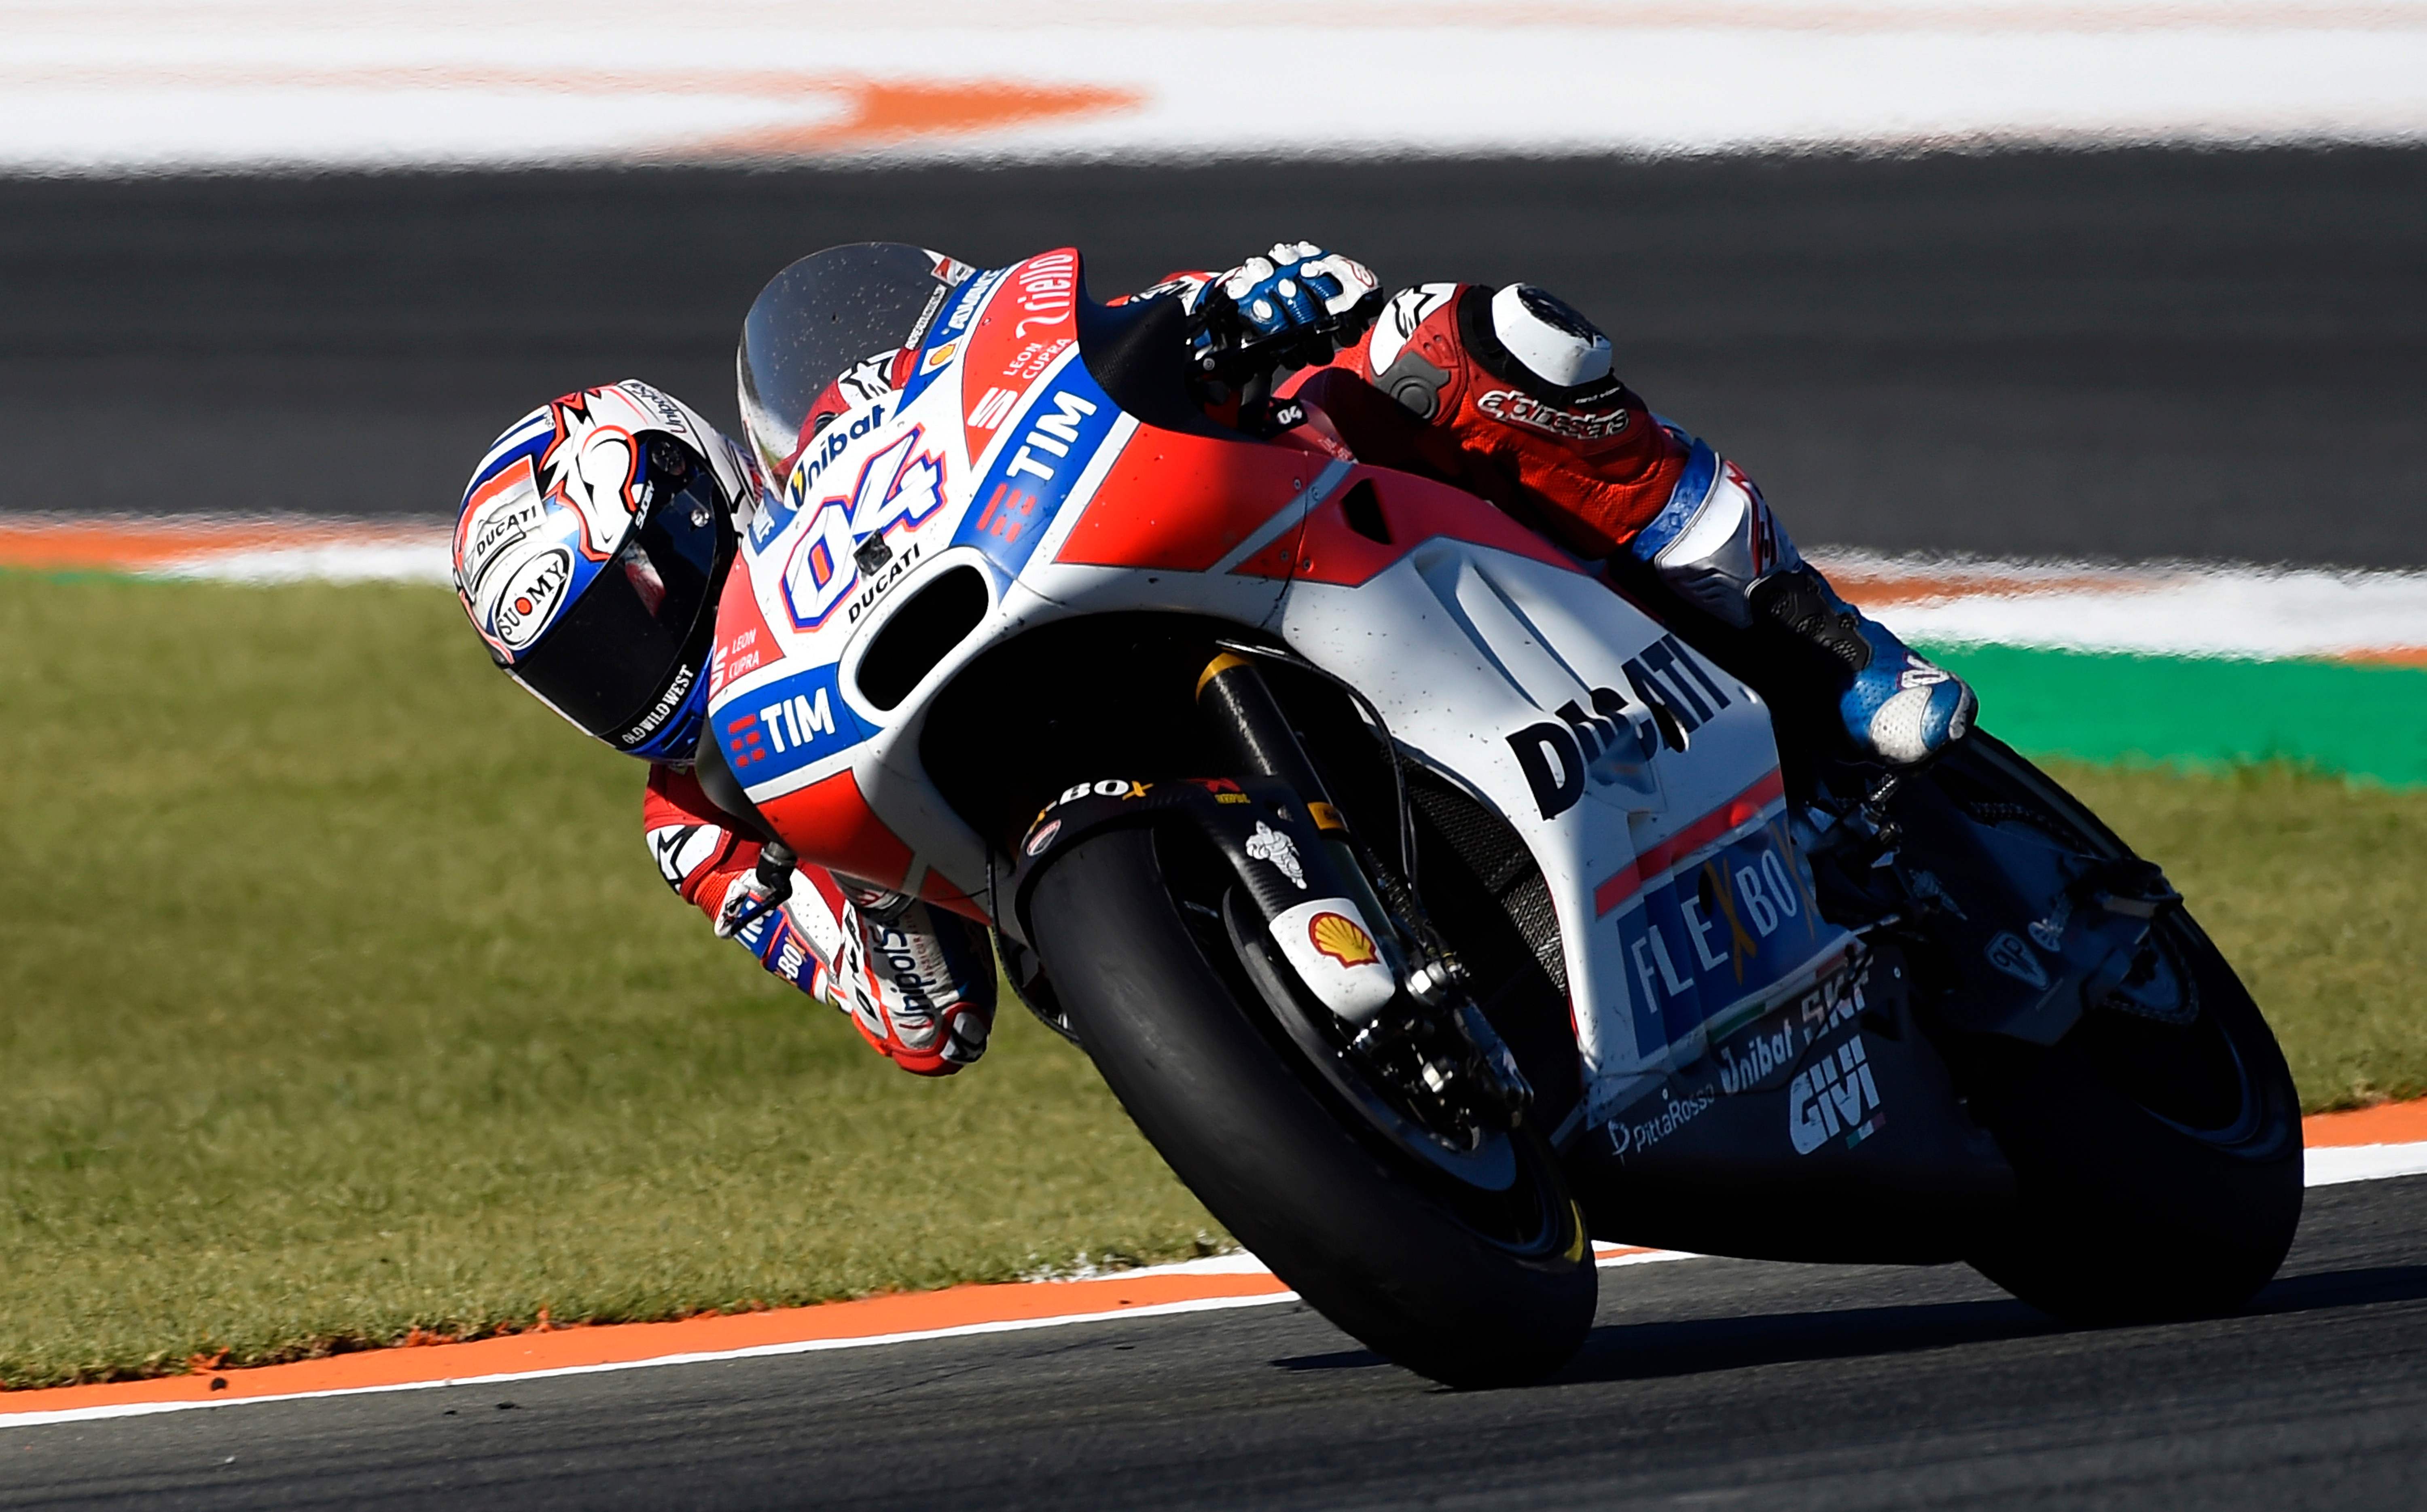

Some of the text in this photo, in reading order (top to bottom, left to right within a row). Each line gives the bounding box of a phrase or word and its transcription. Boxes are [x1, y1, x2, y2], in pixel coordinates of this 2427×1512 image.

[1003, 343, 1042, 376] LEON
[1022, 338, 1072, 379] CUPRA
[1006, 390, 1097, 481] TIM
[1277, 405, 1302, 425] 04
[790, 404, 885, 508] Unibat
[477, 505, 537, 558] DUCATI
[778, 422, 948, 634] 04
[496, 560, 565, 636] SUOMY
[848, 542, 920, 624] DUCATI
[621, 664, 694, 744] OLD WILD WEST
[760, 687, 835, 753] TIM
[1720, 1017, 1793, 1095] Unibat
[1790, 1034, 1881, 1155] GIVI
[1633, 1083, 1715, 1153] PittaRosso
